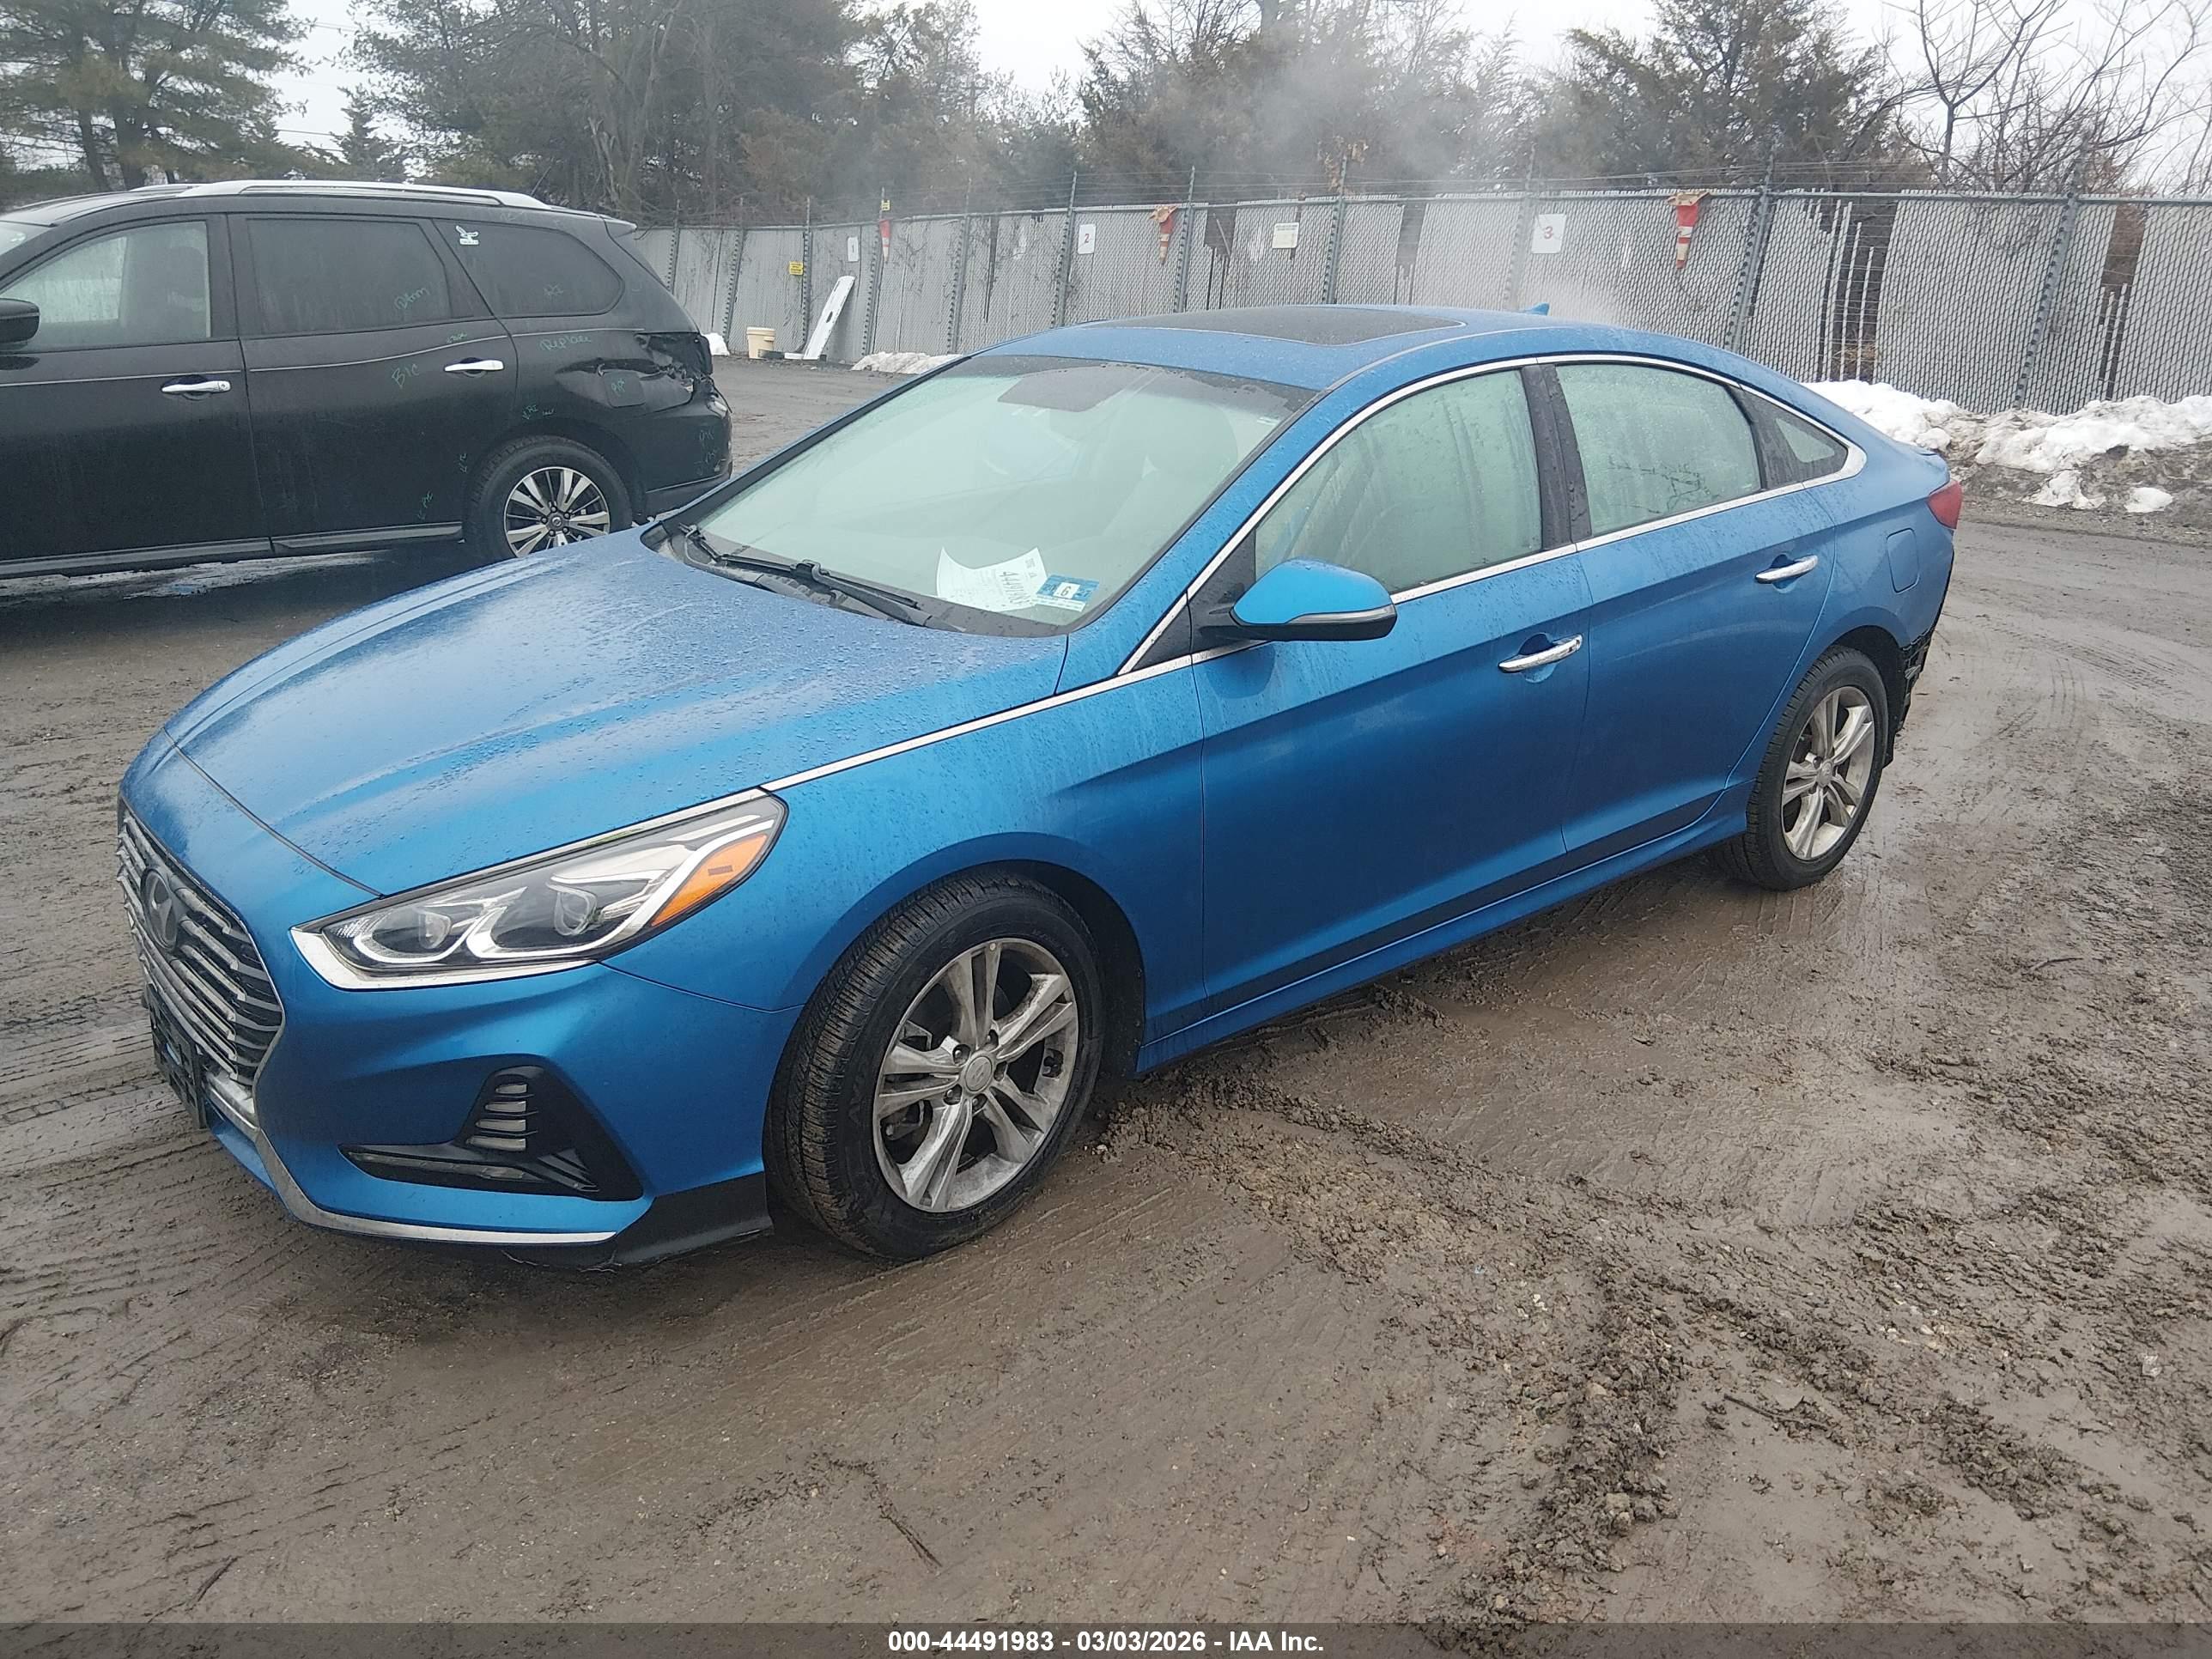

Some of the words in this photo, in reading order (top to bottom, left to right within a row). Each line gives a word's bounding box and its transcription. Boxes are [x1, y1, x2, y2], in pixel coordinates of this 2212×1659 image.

[1084, 233, 1091, 244] 2
[1544, 226, 1553, 240] 3
[1060, 586, 1071, 597] 6
